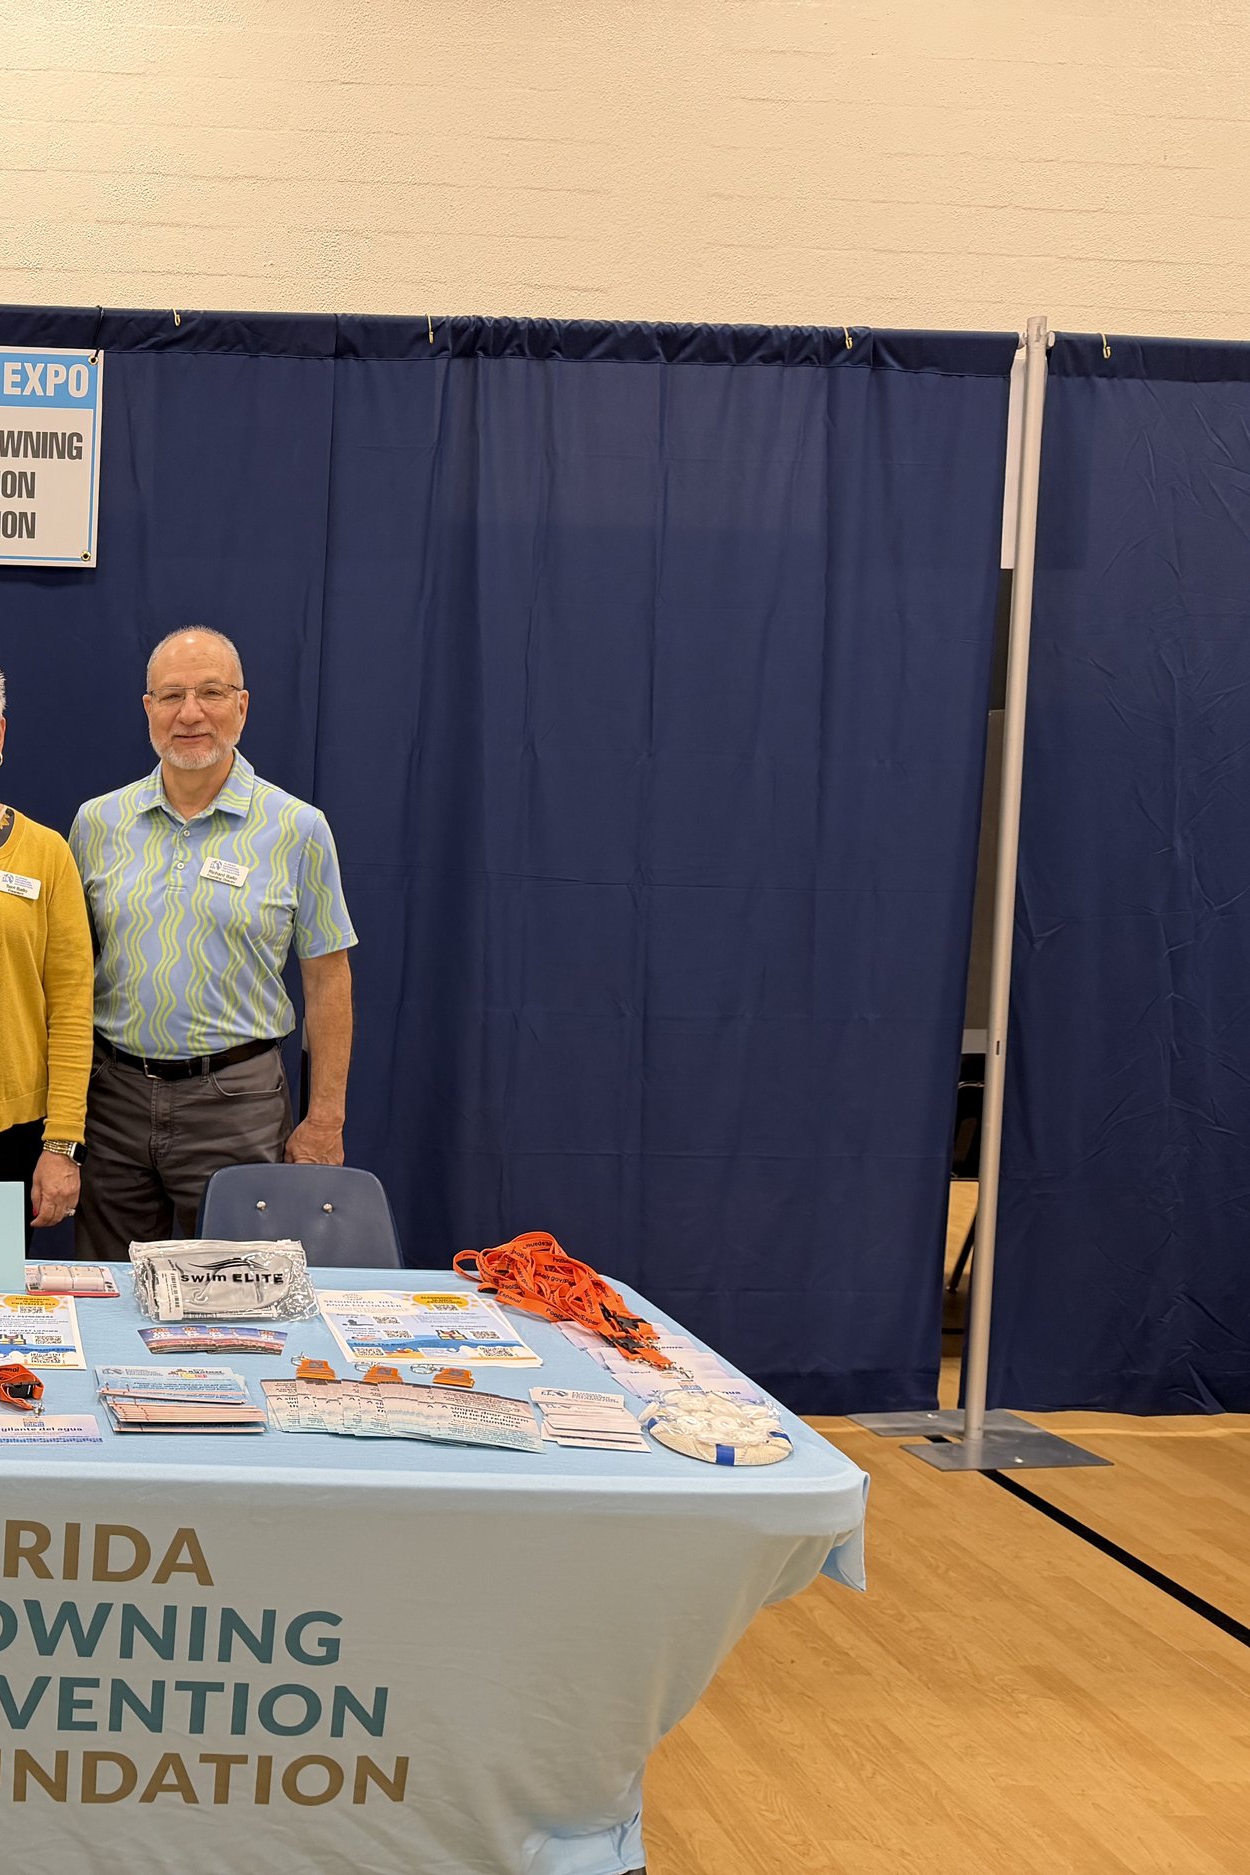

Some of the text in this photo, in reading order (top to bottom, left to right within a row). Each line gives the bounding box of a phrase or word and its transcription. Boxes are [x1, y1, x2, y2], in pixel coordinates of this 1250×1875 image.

[3, 361, 89, 398] EXPO
[180, 1272, 284, 1284] swim ELITE
